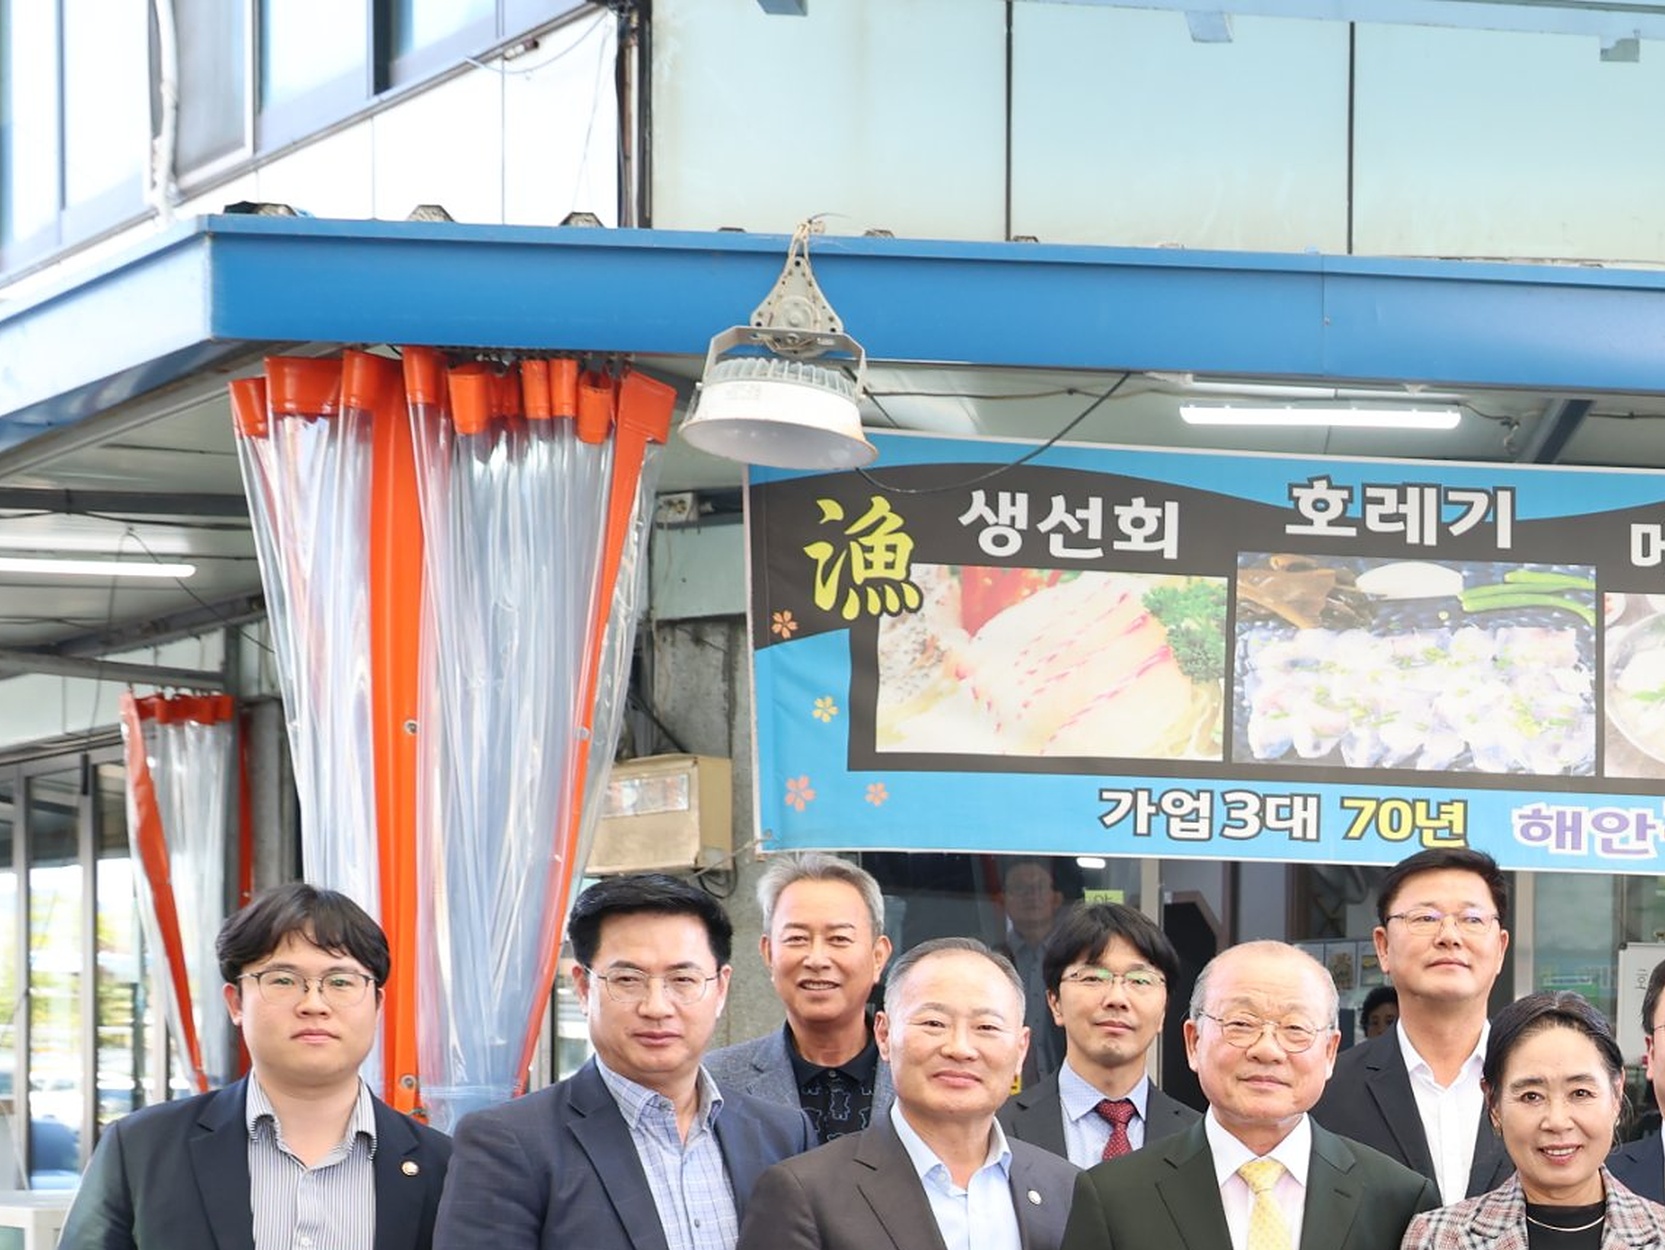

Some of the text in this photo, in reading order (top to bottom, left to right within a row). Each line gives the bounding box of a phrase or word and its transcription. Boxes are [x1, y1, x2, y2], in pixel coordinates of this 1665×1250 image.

[958, 488, 1179, 560] 생선회
[1284, 475, 1515, 550] 호레기
[805, 496, 922, 618] 漁
[1340, 796, 1469, 849] 70년
